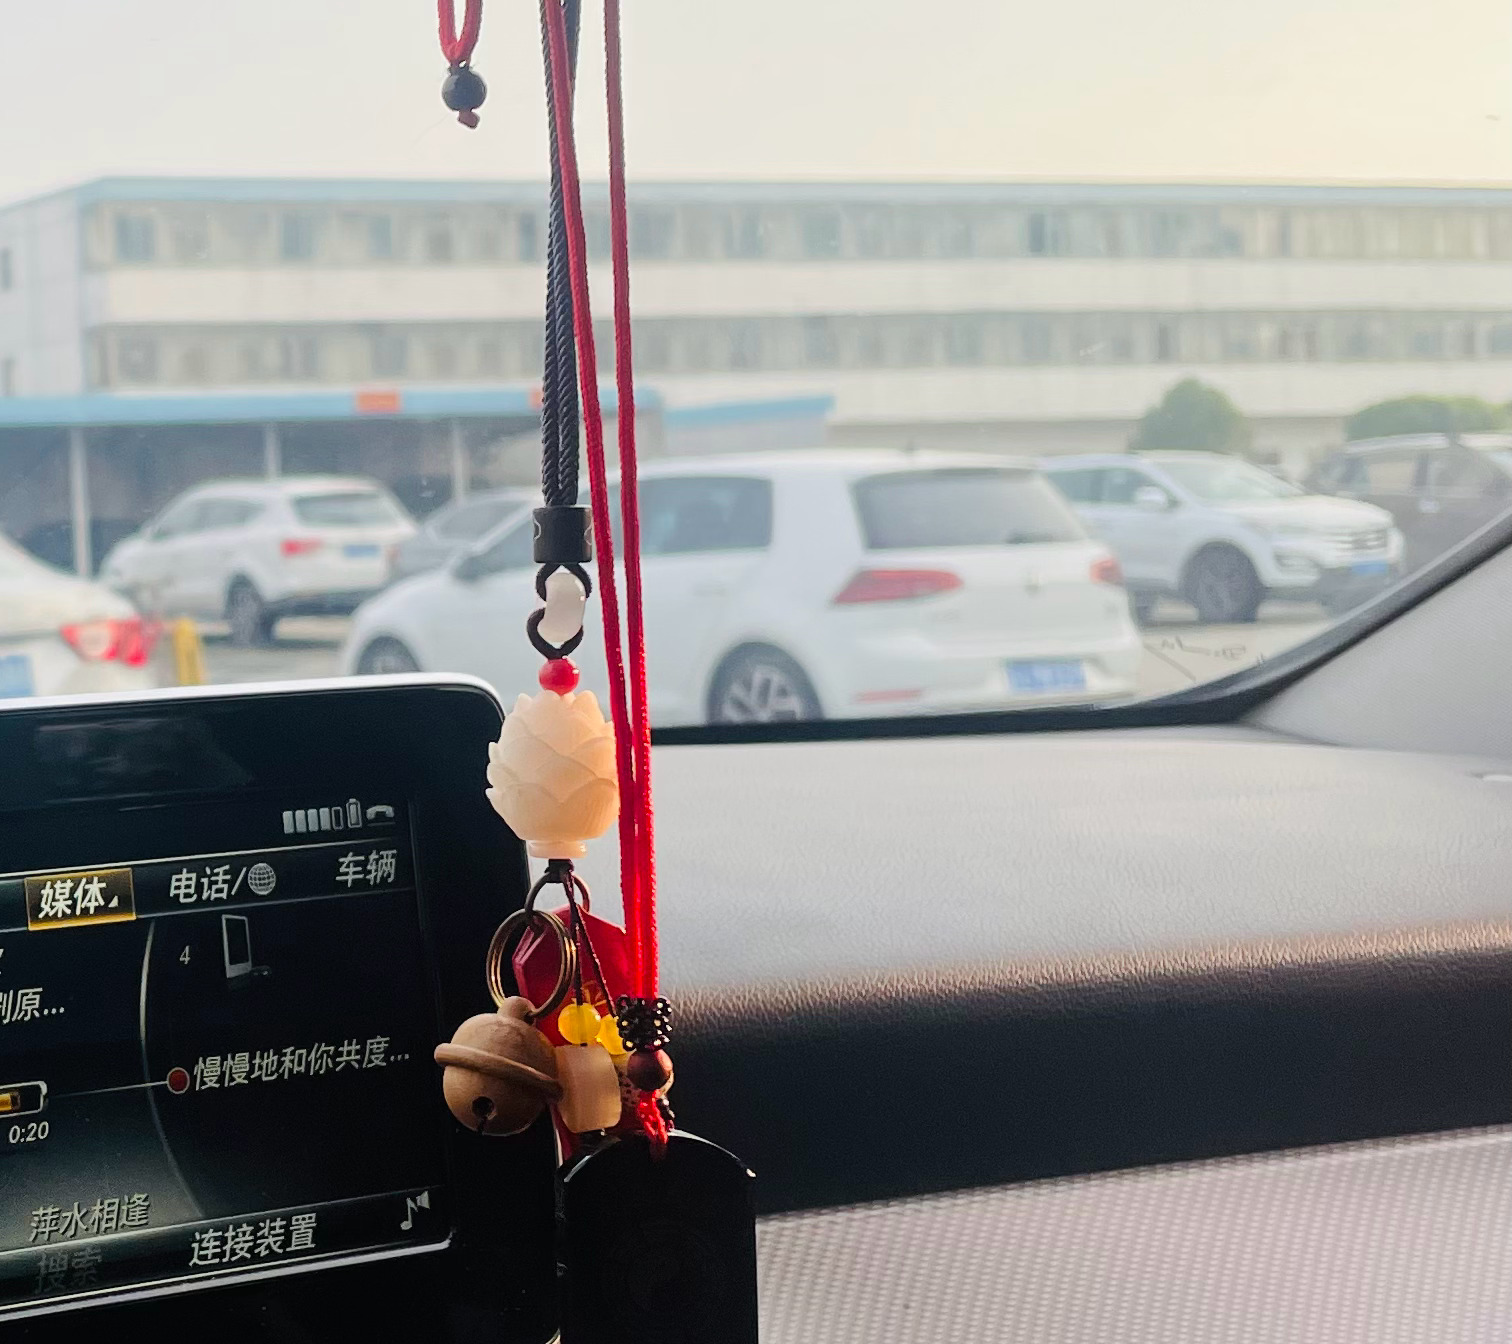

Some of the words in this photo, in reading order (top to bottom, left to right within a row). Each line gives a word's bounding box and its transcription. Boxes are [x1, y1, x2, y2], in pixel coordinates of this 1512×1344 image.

[336, 849, 397, 888] 车辆
[38, 876, 109, 919] 媒体
[179, 944, 192, 965] 4
[8, 1121, 50, 1145] 0:20
[28, 1192, 152, 1244] 萍水相逢
[188, 1213, 318, 1268] 连接装置
